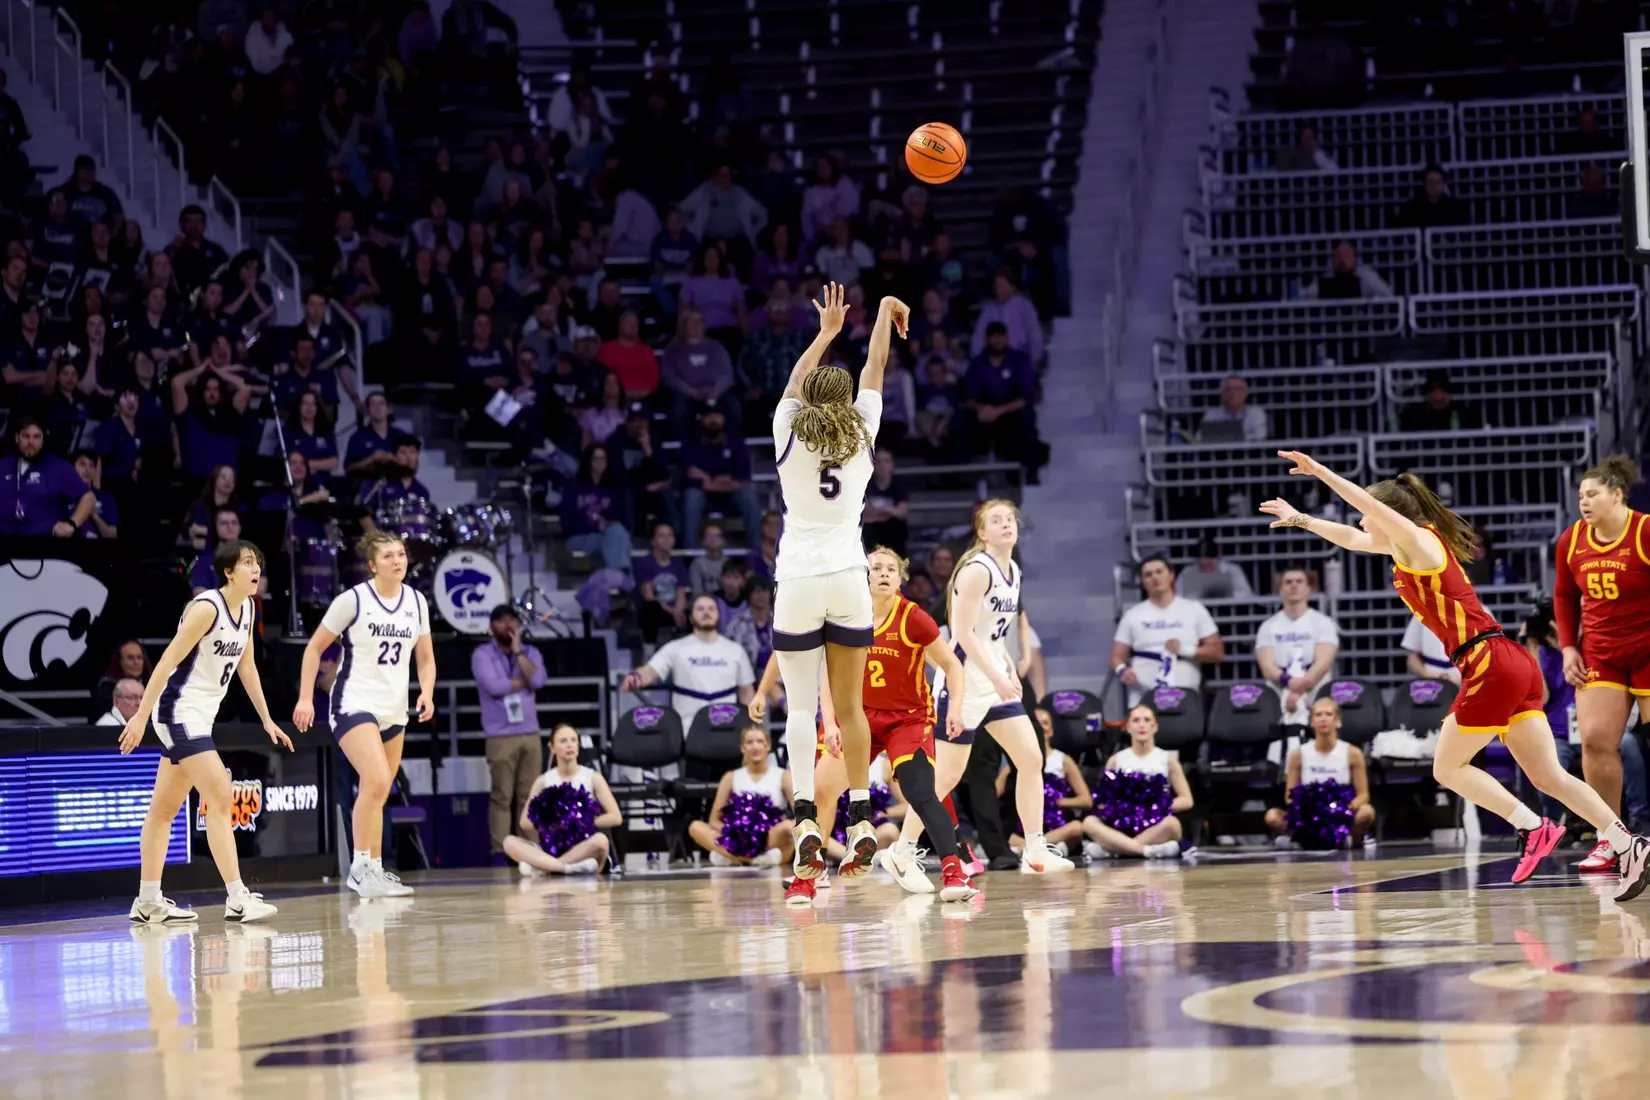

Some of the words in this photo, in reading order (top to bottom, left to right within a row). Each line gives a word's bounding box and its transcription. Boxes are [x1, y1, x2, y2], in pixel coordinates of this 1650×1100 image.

[915, 135, 946, 154] ELITE
[819, 460, 842, 500] 5
[1580, 561, 1599, 572] IOWA
[1600, 560, 1627, 571] STATE
[1587, 572, 1619, 600] 55
[368, 622, 412, 639] Wildcats
[377, 640, 402, 666] 23
[872, 646, 900, 658] STATE
[220, 661, 233, 687] 6
[868, 660, 886, 688] 2
[265, 786, 294, 812] SINCE
[294, 784, 318, 810] 1979
